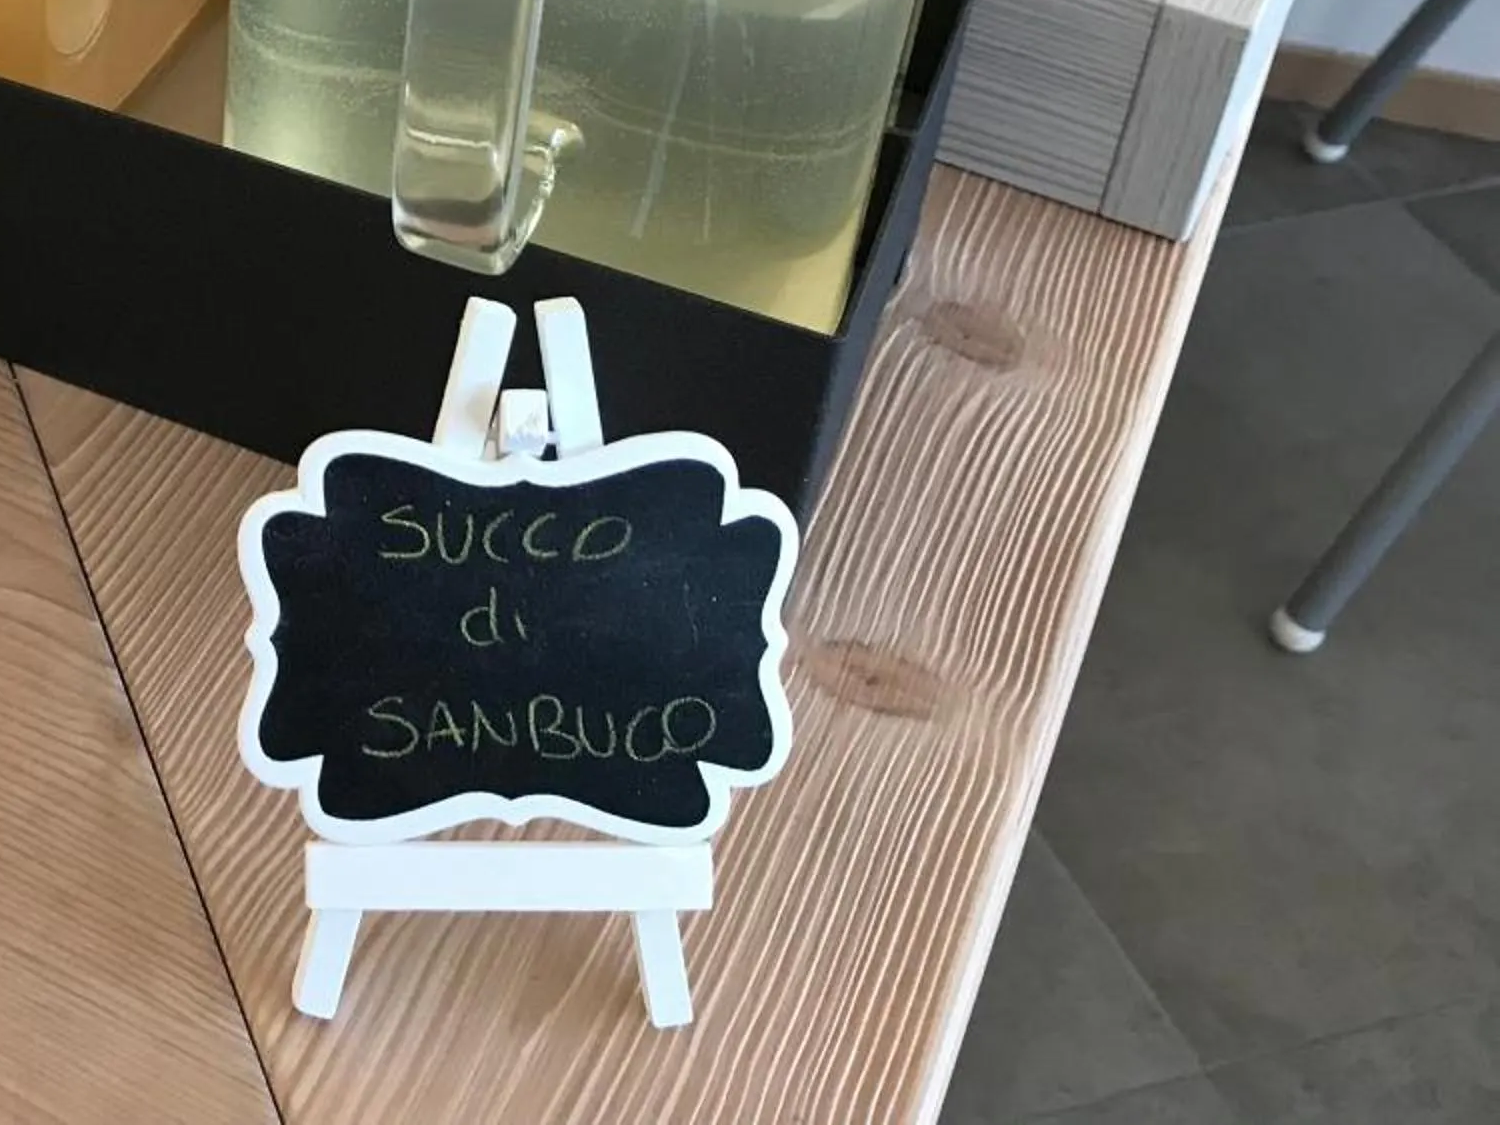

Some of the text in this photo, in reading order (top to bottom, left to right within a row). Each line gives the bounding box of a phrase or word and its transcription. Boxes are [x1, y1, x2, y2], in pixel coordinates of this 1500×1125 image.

[378, 504, 633, 565] SUCCO
[459, 586, 530, 647] di
[361, 693, 717, 763] SANBUCO
